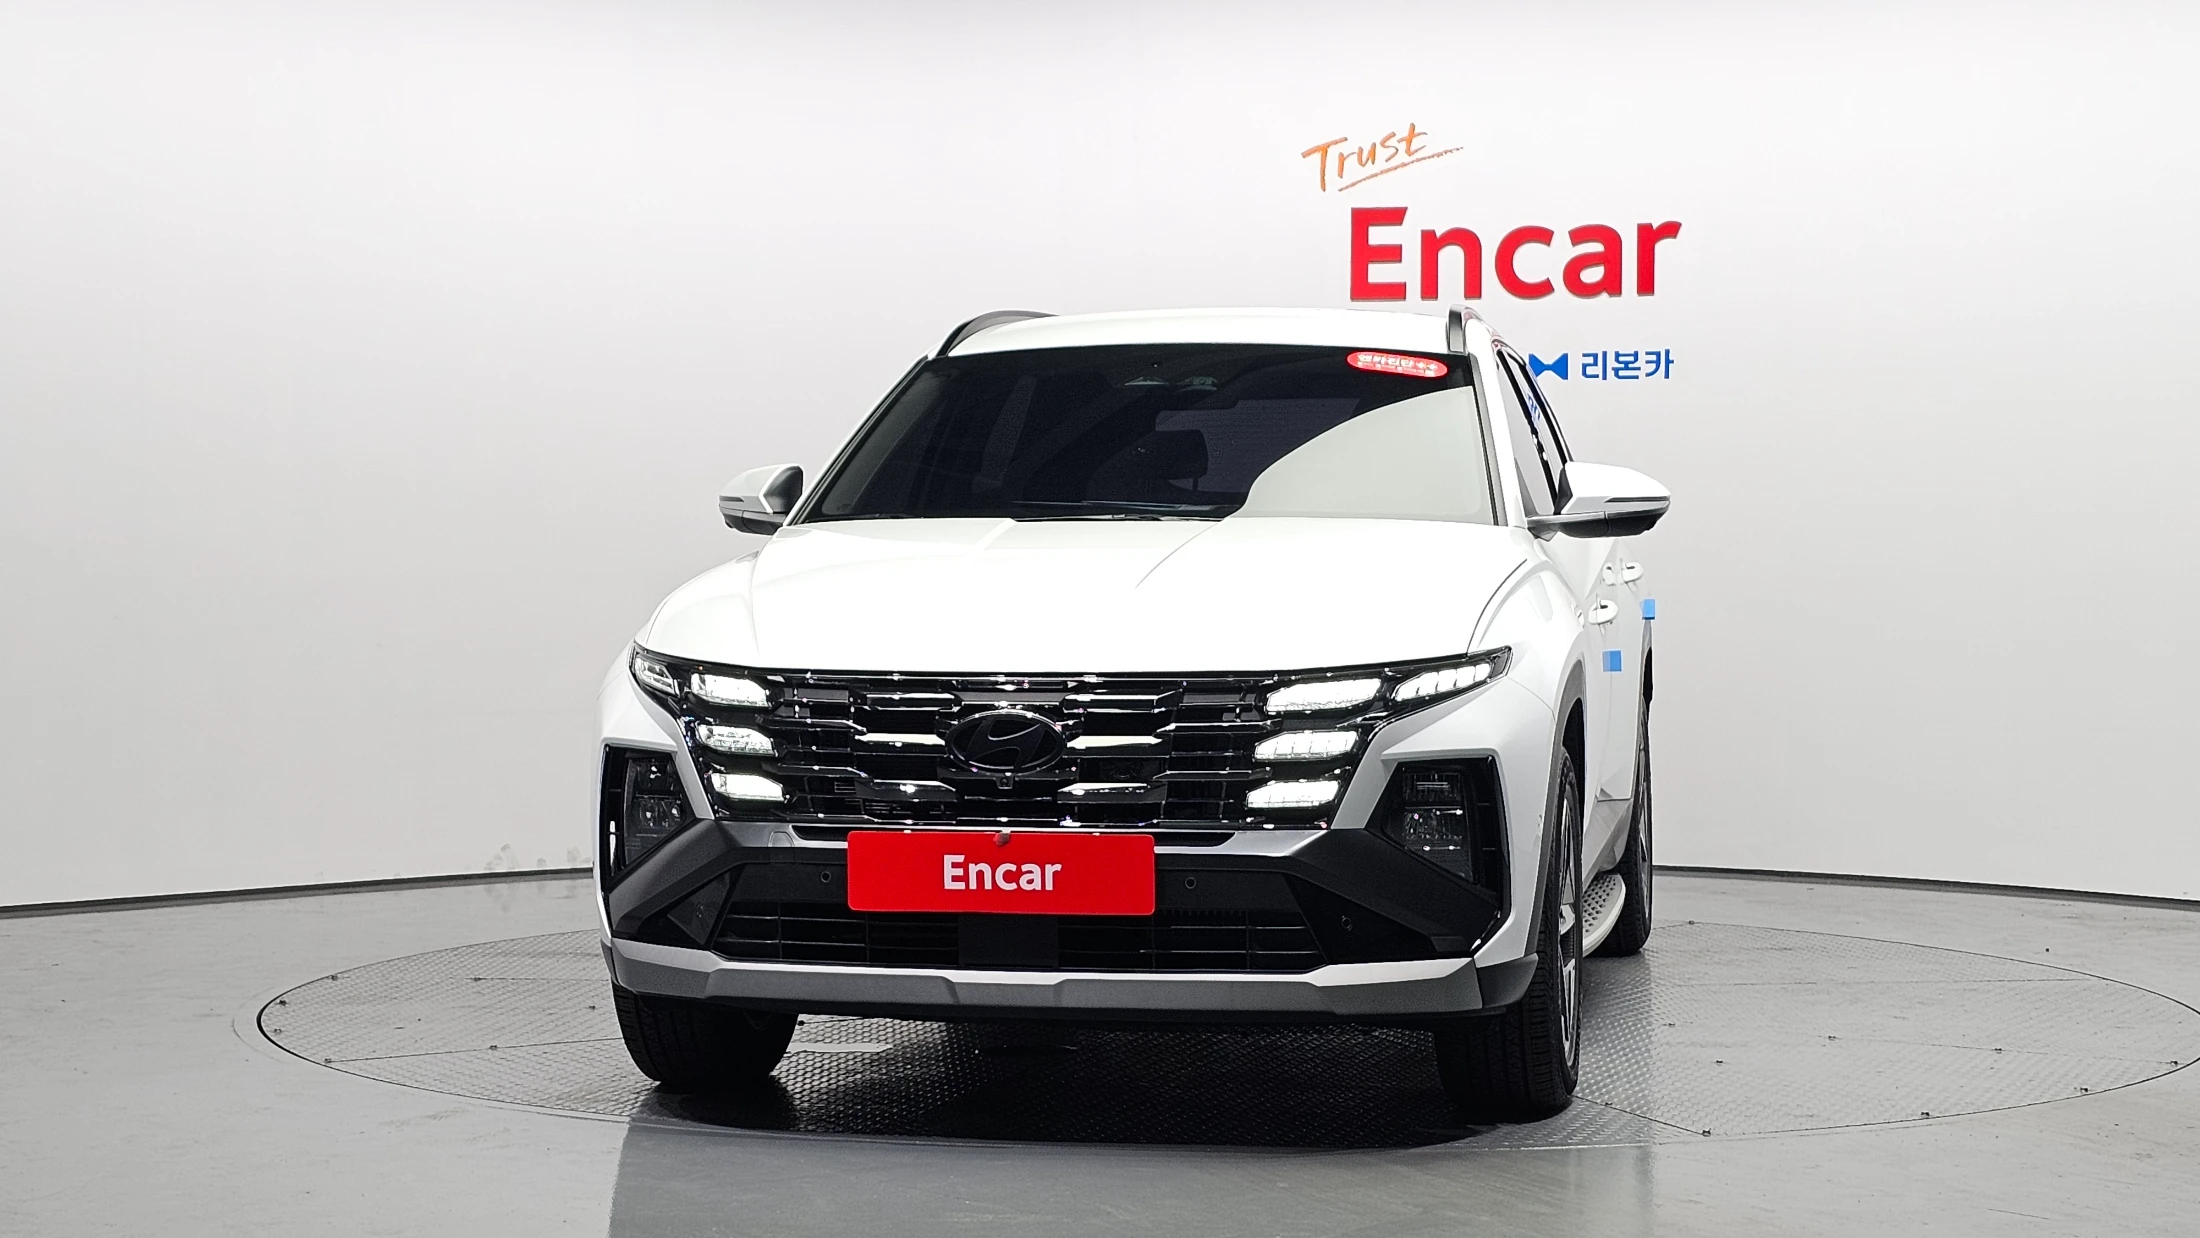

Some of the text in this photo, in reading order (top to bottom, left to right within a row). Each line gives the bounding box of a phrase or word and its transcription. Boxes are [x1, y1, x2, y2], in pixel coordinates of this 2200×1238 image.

[1302, 123, 1428, 191] Trust
[1350, 206, 1682, 301] Encar
[1581, 348, 1675, 381] 리본카
[943, 854, 1062, 891] Encar
